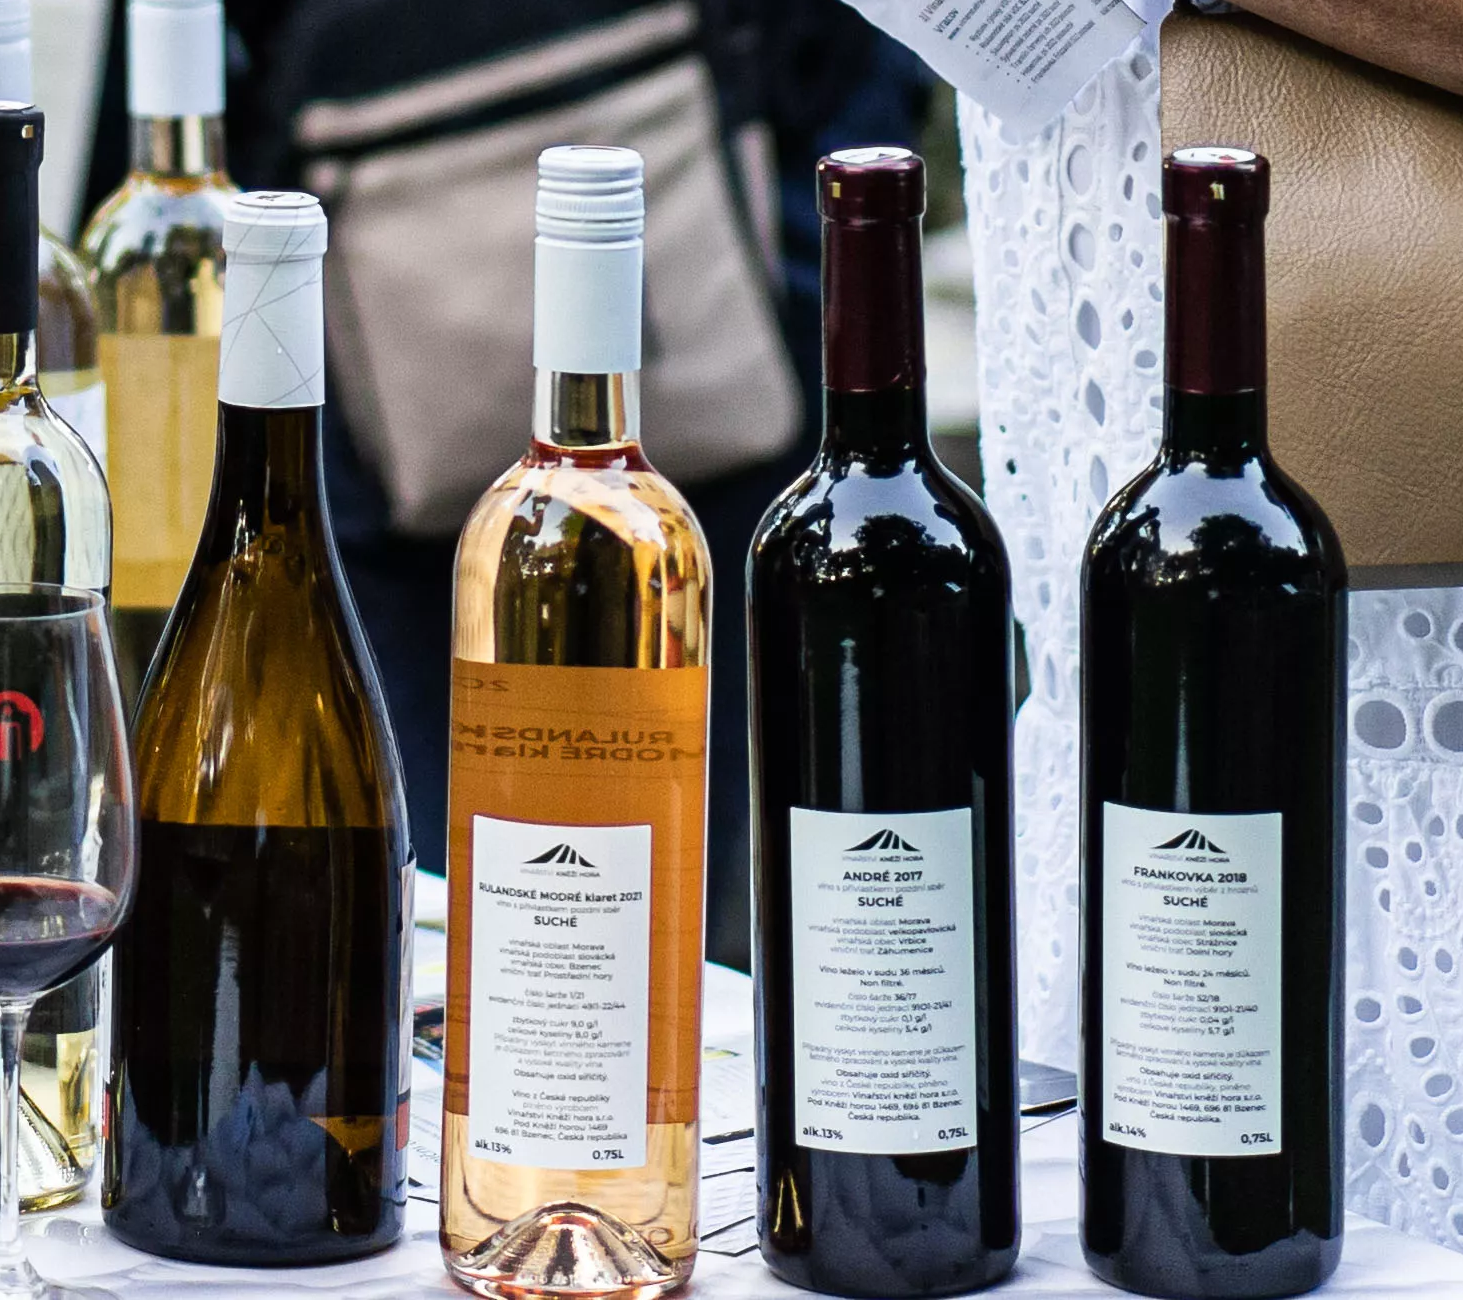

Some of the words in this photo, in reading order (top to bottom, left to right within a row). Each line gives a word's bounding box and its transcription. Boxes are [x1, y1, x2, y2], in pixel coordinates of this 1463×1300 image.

[843, 869, 889, 882] ANDRÉ
[894, 871, 923, 881] 2017
[1134, 866, 1214, 883] FRANKOVKA
[1217, 872, 1248, 883] 2018
[479, 882, 537, 899] RULANDSKÉ
[540, 891, 582, 902] MODRÉ
[585, 892, 617, 902] klaret
[619, 891, 643, 901] 2021
[858, 894, 904, 907] SUCHÉ
[1163, 895, 1208, 908] SUCHÉ
[534, 915, 578, 927] SUCHÉ
[802, 1126, 843, 1140] alk.13%
[938, 1126, 969, 1141] 0,75L
[1109, 1122, 1146, 1138] alk.14%
[1240, 1132, 1274, 1145] 0,75L
